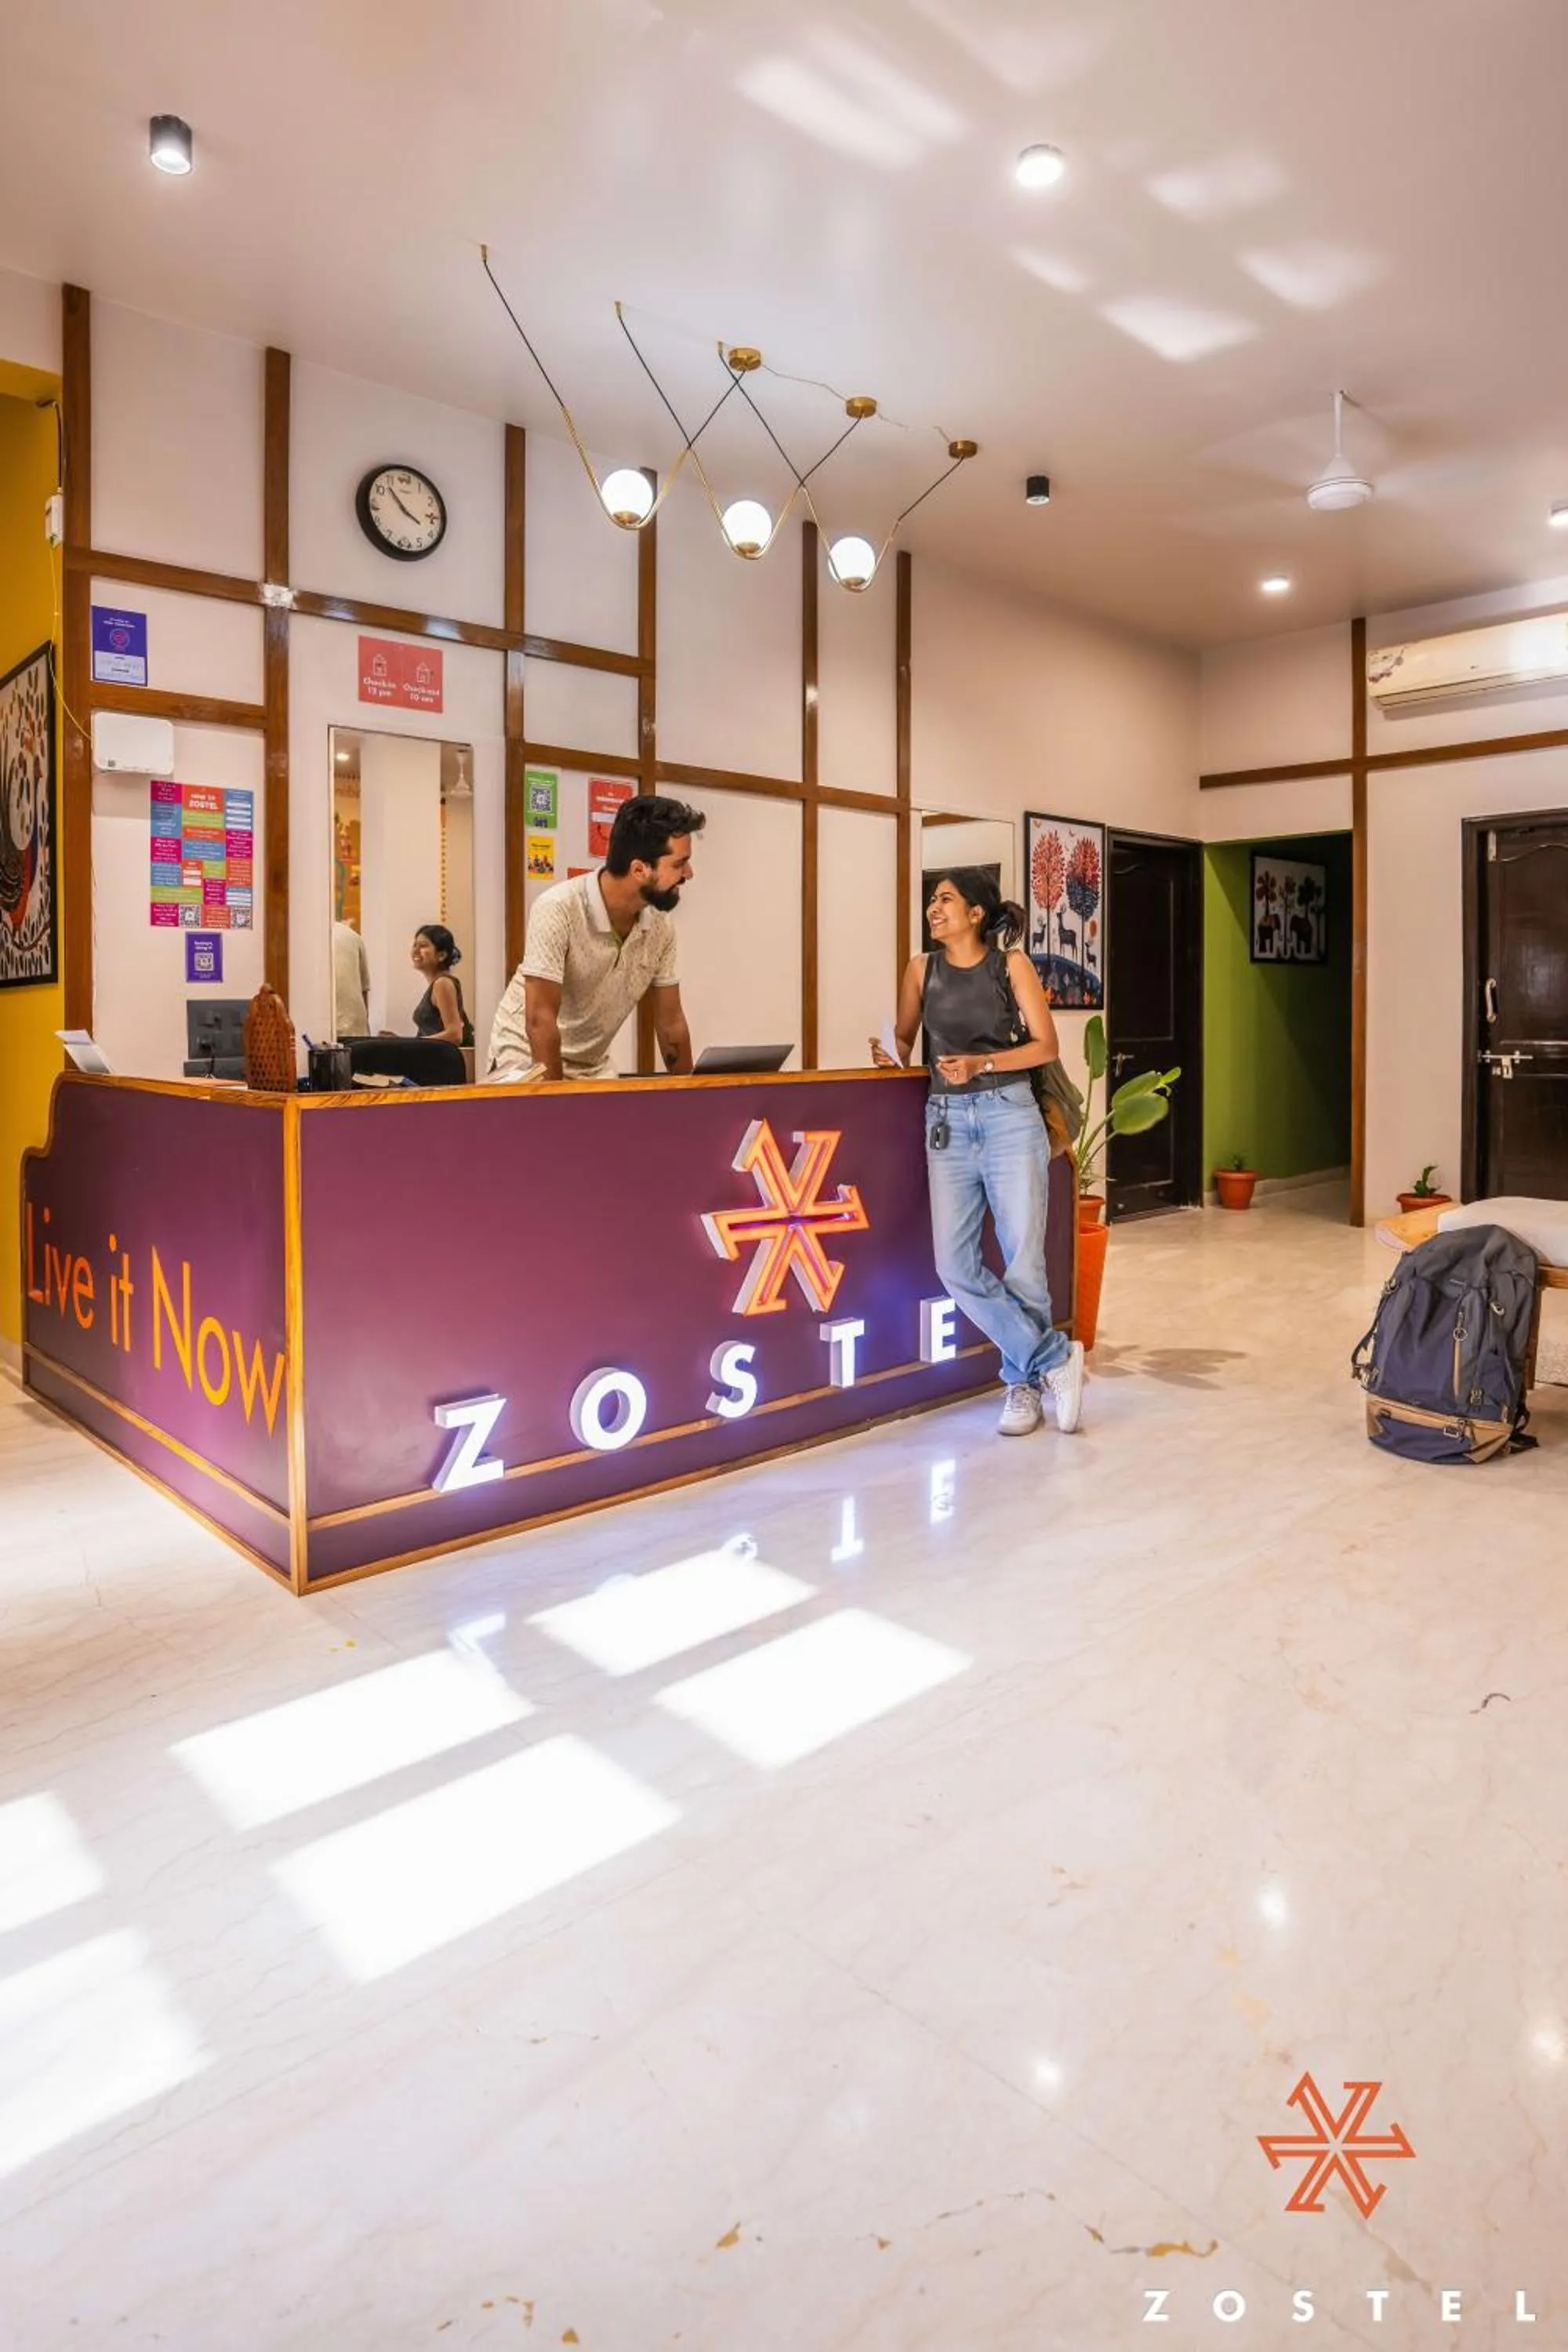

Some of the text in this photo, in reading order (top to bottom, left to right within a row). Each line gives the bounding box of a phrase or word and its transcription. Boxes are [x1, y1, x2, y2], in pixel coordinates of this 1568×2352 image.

[27, 1202, 285, 1438] Live it Now
